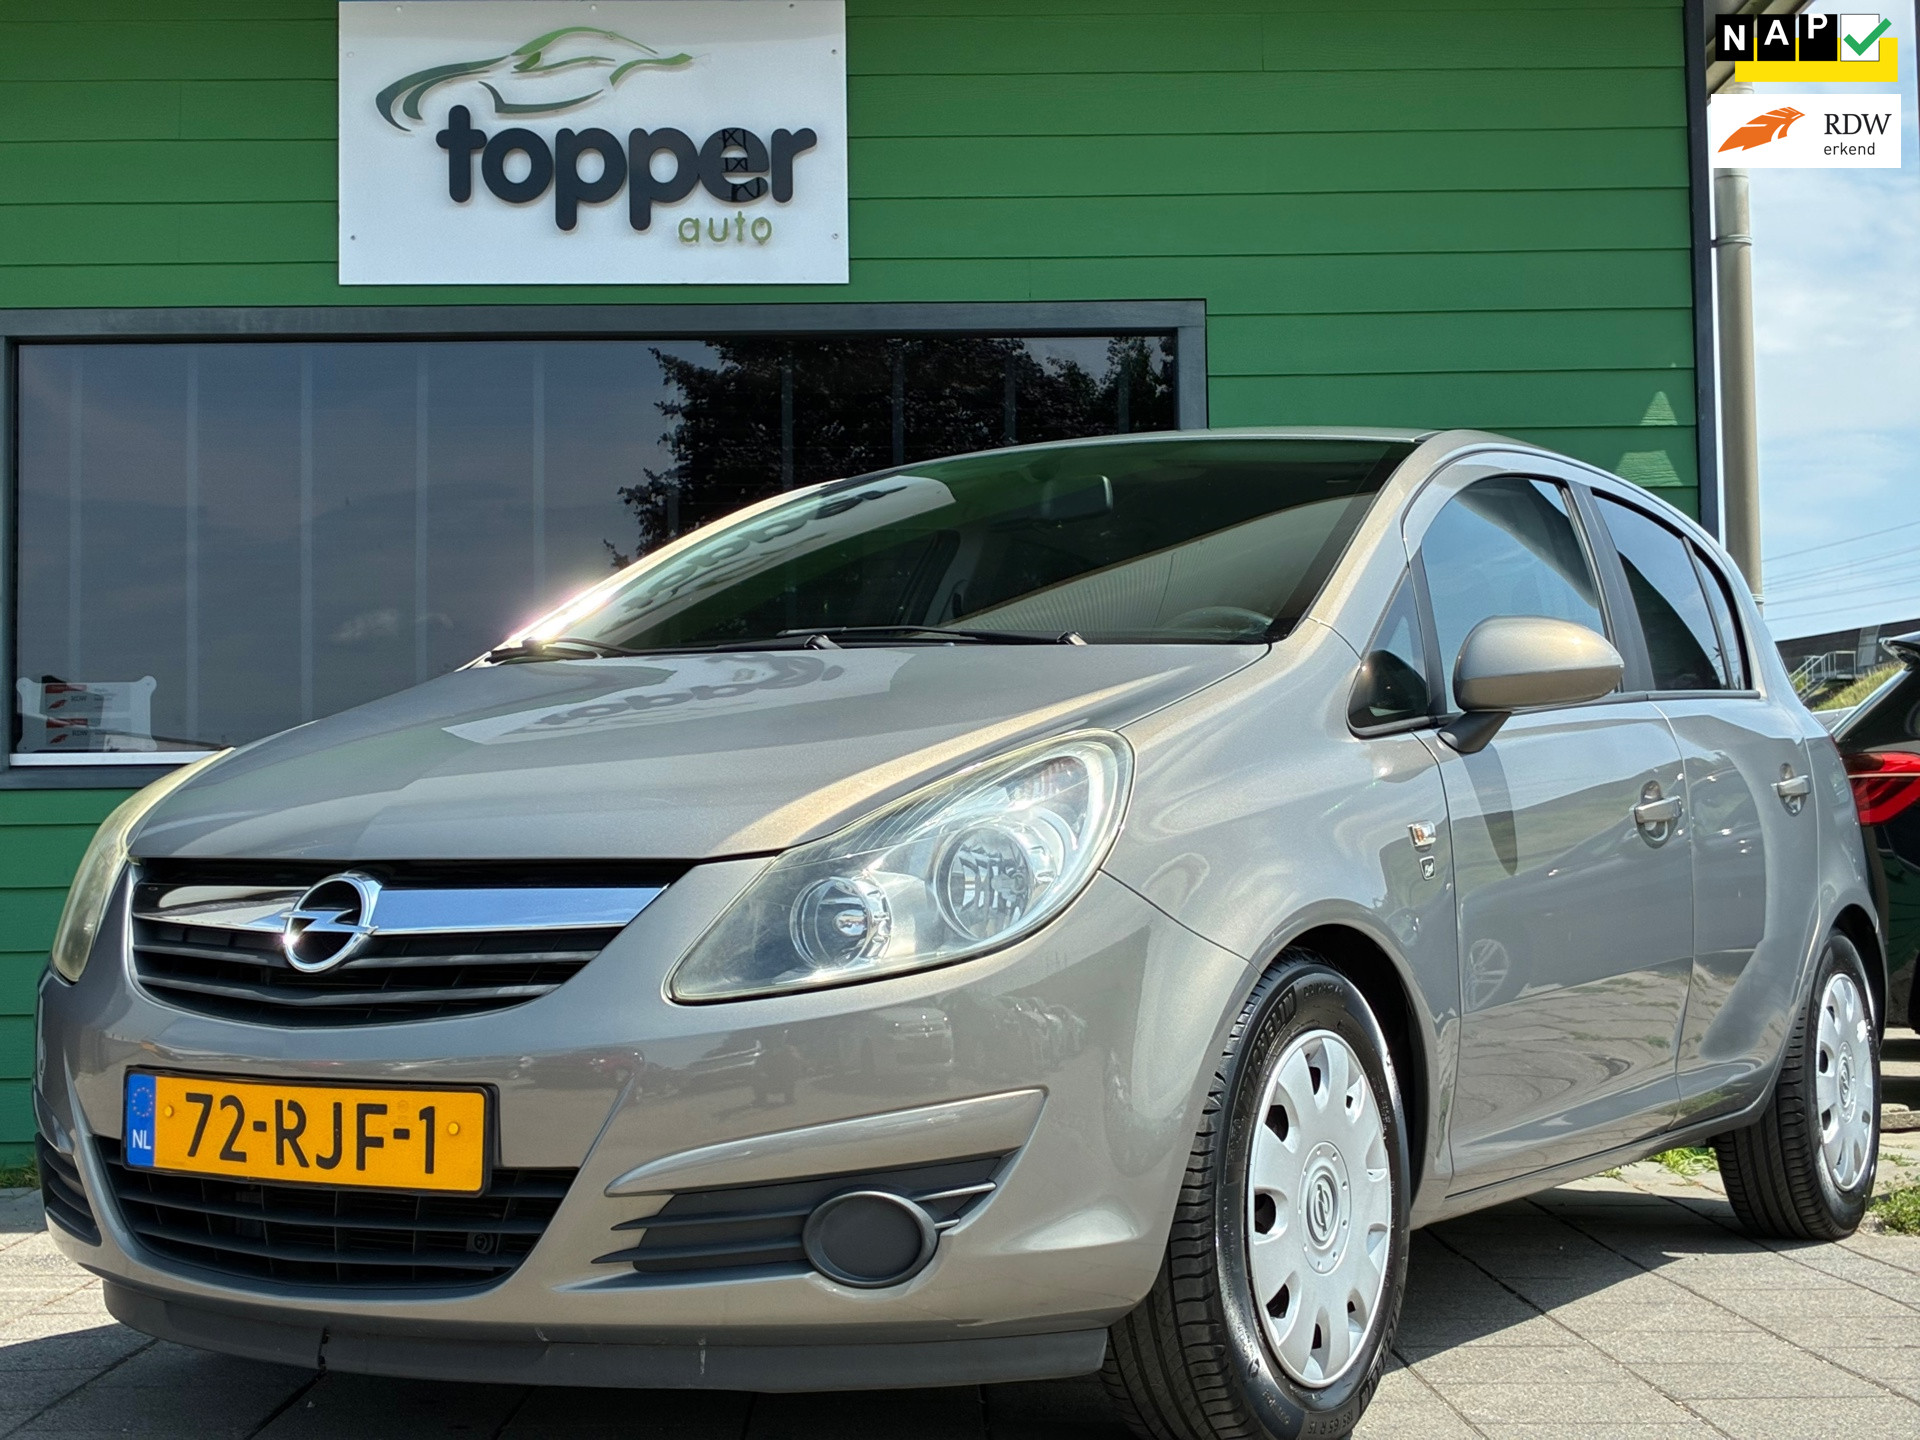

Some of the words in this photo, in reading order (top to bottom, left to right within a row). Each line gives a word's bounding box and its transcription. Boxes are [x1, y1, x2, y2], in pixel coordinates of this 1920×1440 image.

[435, 104, 818, 232] topper
[678, 210, 773, 245] auto
[132, 1129, 152, 1151] NL
[184, 1092, 436, 1175] 72-RJF-1
